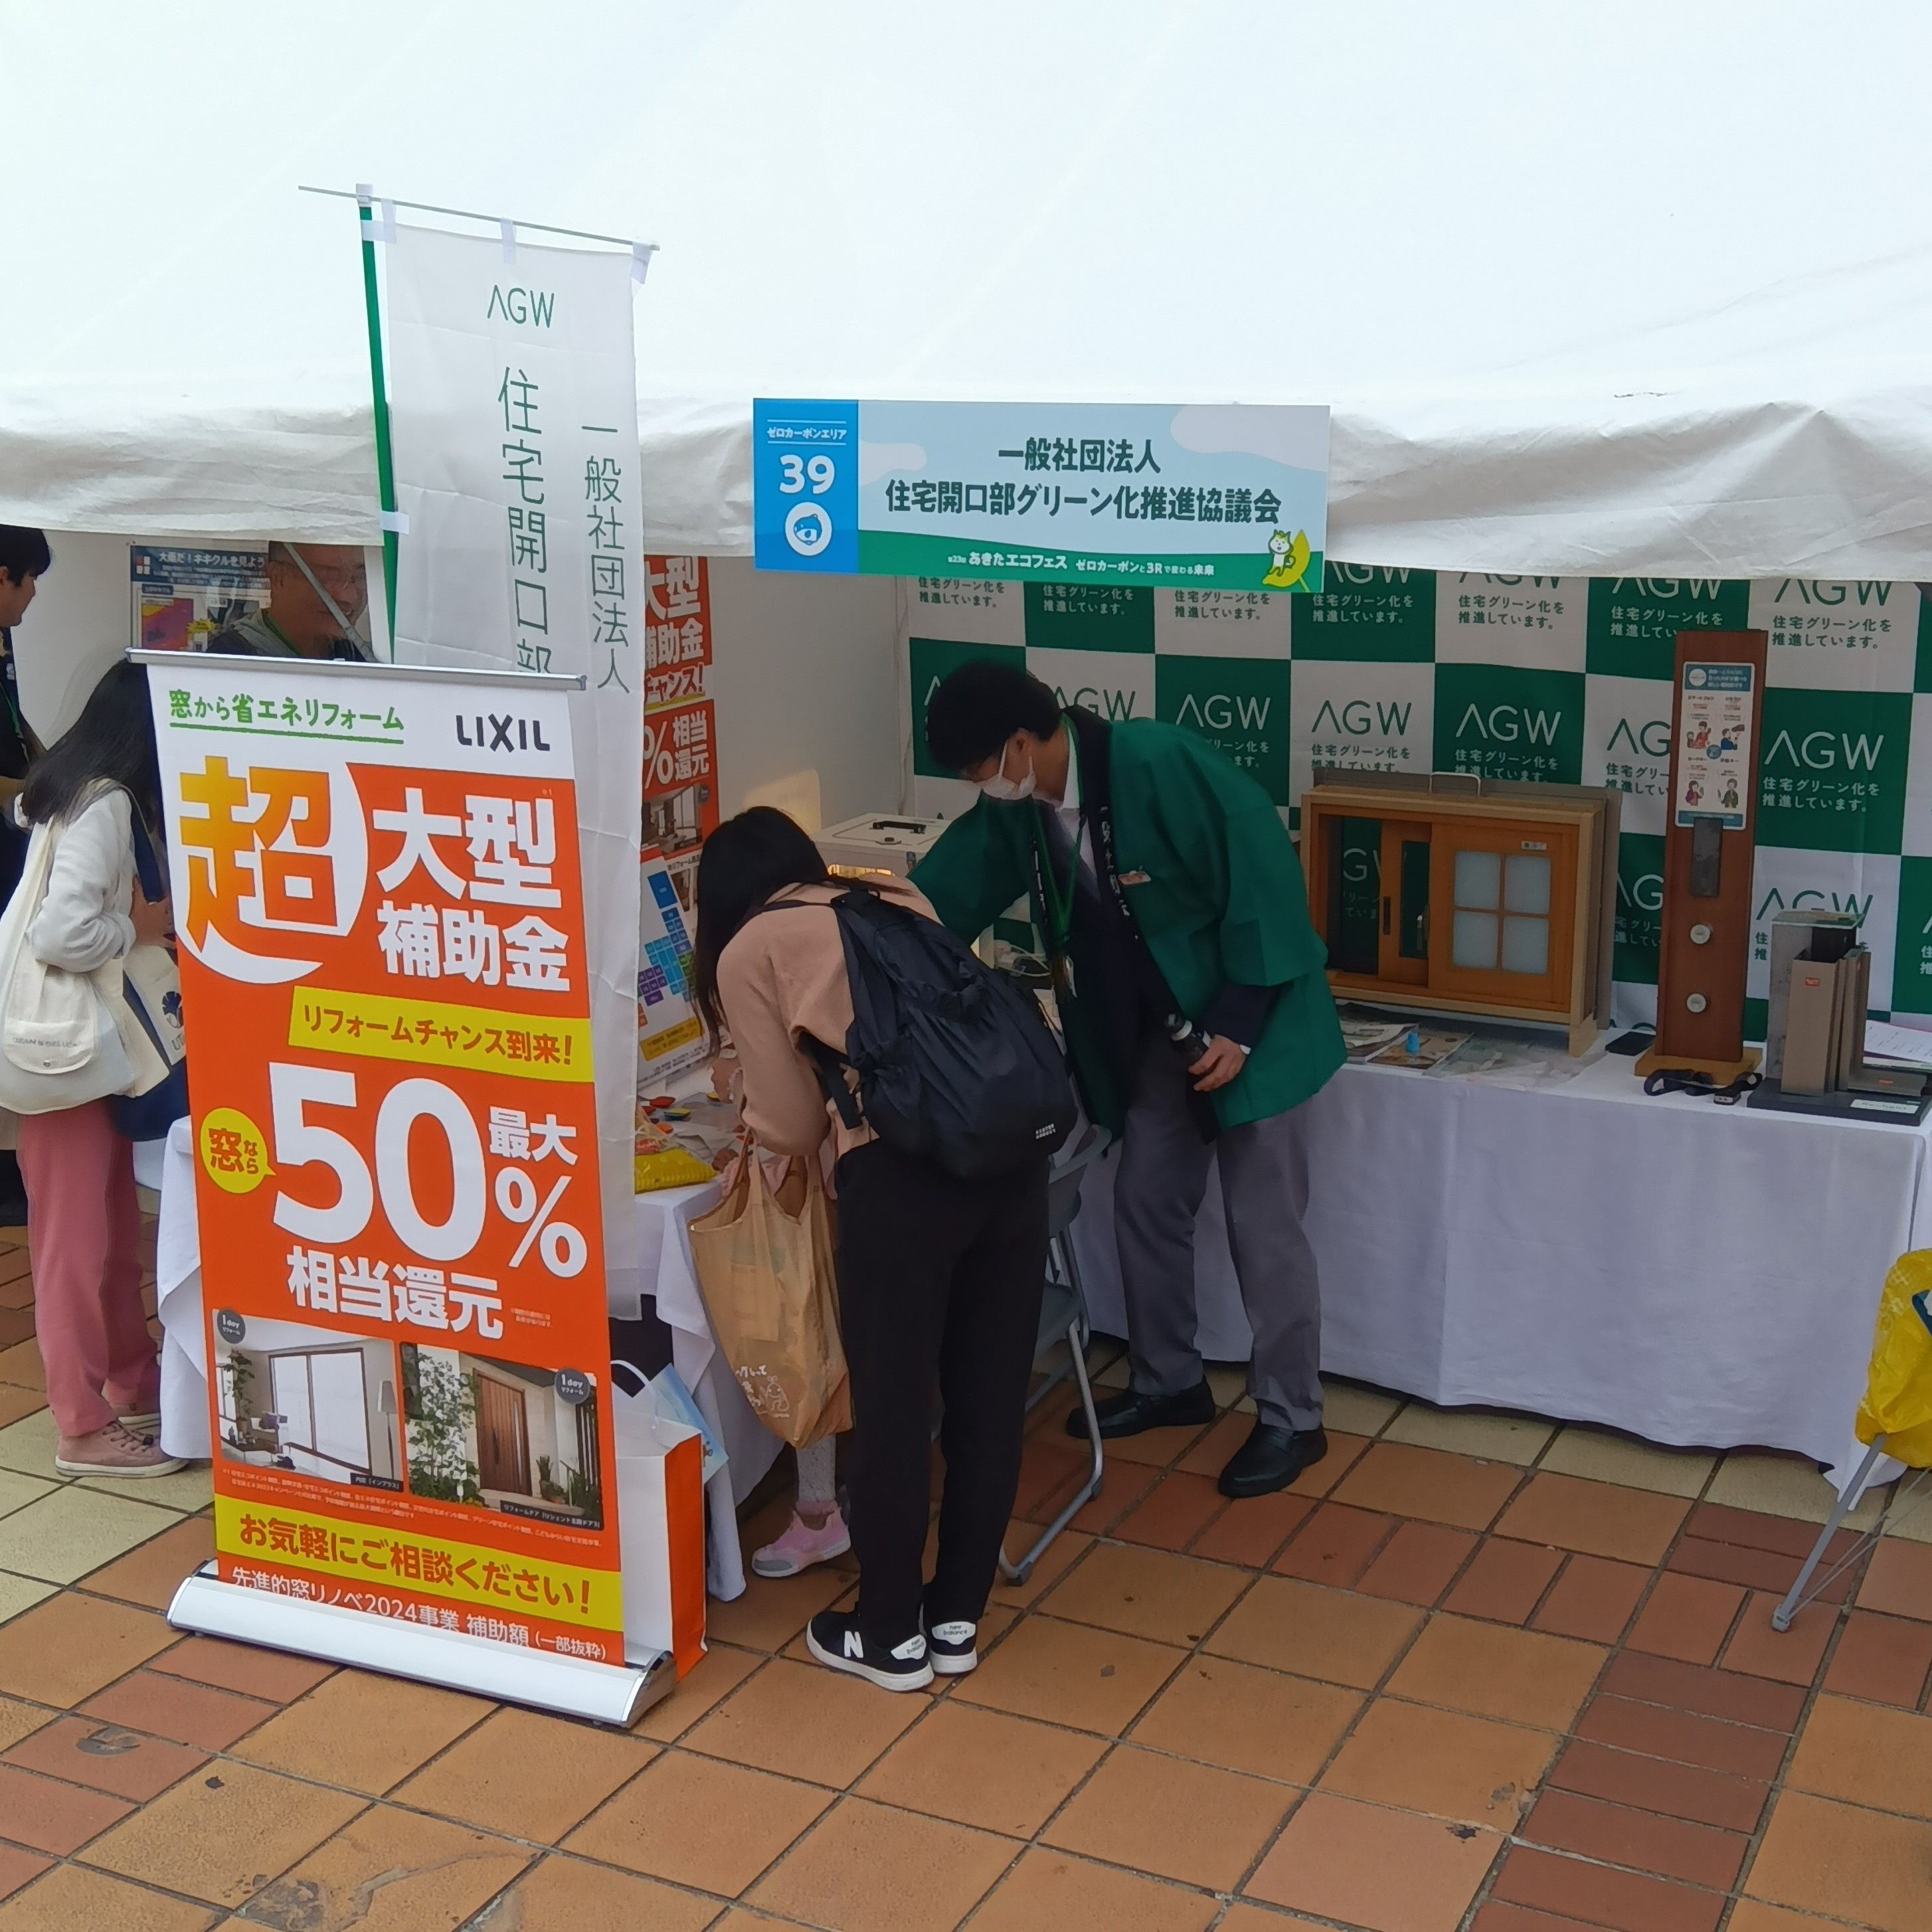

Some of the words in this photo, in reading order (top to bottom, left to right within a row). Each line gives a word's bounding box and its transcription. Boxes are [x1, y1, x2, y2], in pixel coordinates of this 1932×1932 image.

[487, 284, 555, 328] AGW
[766, 426, 847, 440] ゼロカーボンエリア
[779, 454, 835, 494] 39
[998, 436, 1161, 474] 一般社団法人
[885, 479, 1282, 525] 住宅開口部グリーン化推進協議会
[581, 425, 630, 694] 一般社団法人
[968, 551, 1068, 570] あきたエコフェス
[1458, 595, 1565, 614] 住宅グリーン化を
[1458, 611, 1553, 630] 推進しています。
[1611, 606, 1723, 626] 住宅グリーン化を
[1773, 615, 1892, 632] 住宅グリーン化を
[1611, 622, 1678, 639] 推進してい
[1772, 632, 1878, 650] 推進しています。
[169, 689, 404, 731] 窓から省エネリフォーム
[1176, 693, 1271, 731] AGW
[1312, 699, 1412, 736] AGW
[1455, 703, 1561, 746] AGW
[456, 713, 550, 752] LIXIL
[1607, 718, 1672, 757] AG
[1764, 730, 1884, 771] AGW
[1311, 744, 1411, 760] 住宅グリーン化を
[1454, 748, 1559, 770] 住宅グリーン化を
[1606, 762, 1670, 780] 住宅グリー
[1762, 794, 1867, 813] 推進しています。
[1763, 776, 1880, 796] 住宅グリーン化を
[373, 786, 563, 909] 大型
[376, 899, 571, 992] 補助金
[304, 1004, 572, 1065] リフォームチャンス到来！
[487, 1105, 578, 1166] 最大
[286, 1245, 503, 1340] 相当還元
[239, 1513, 590, 1615] お気軽にご相談ください！
[844, 1630, 864, 1658] N
